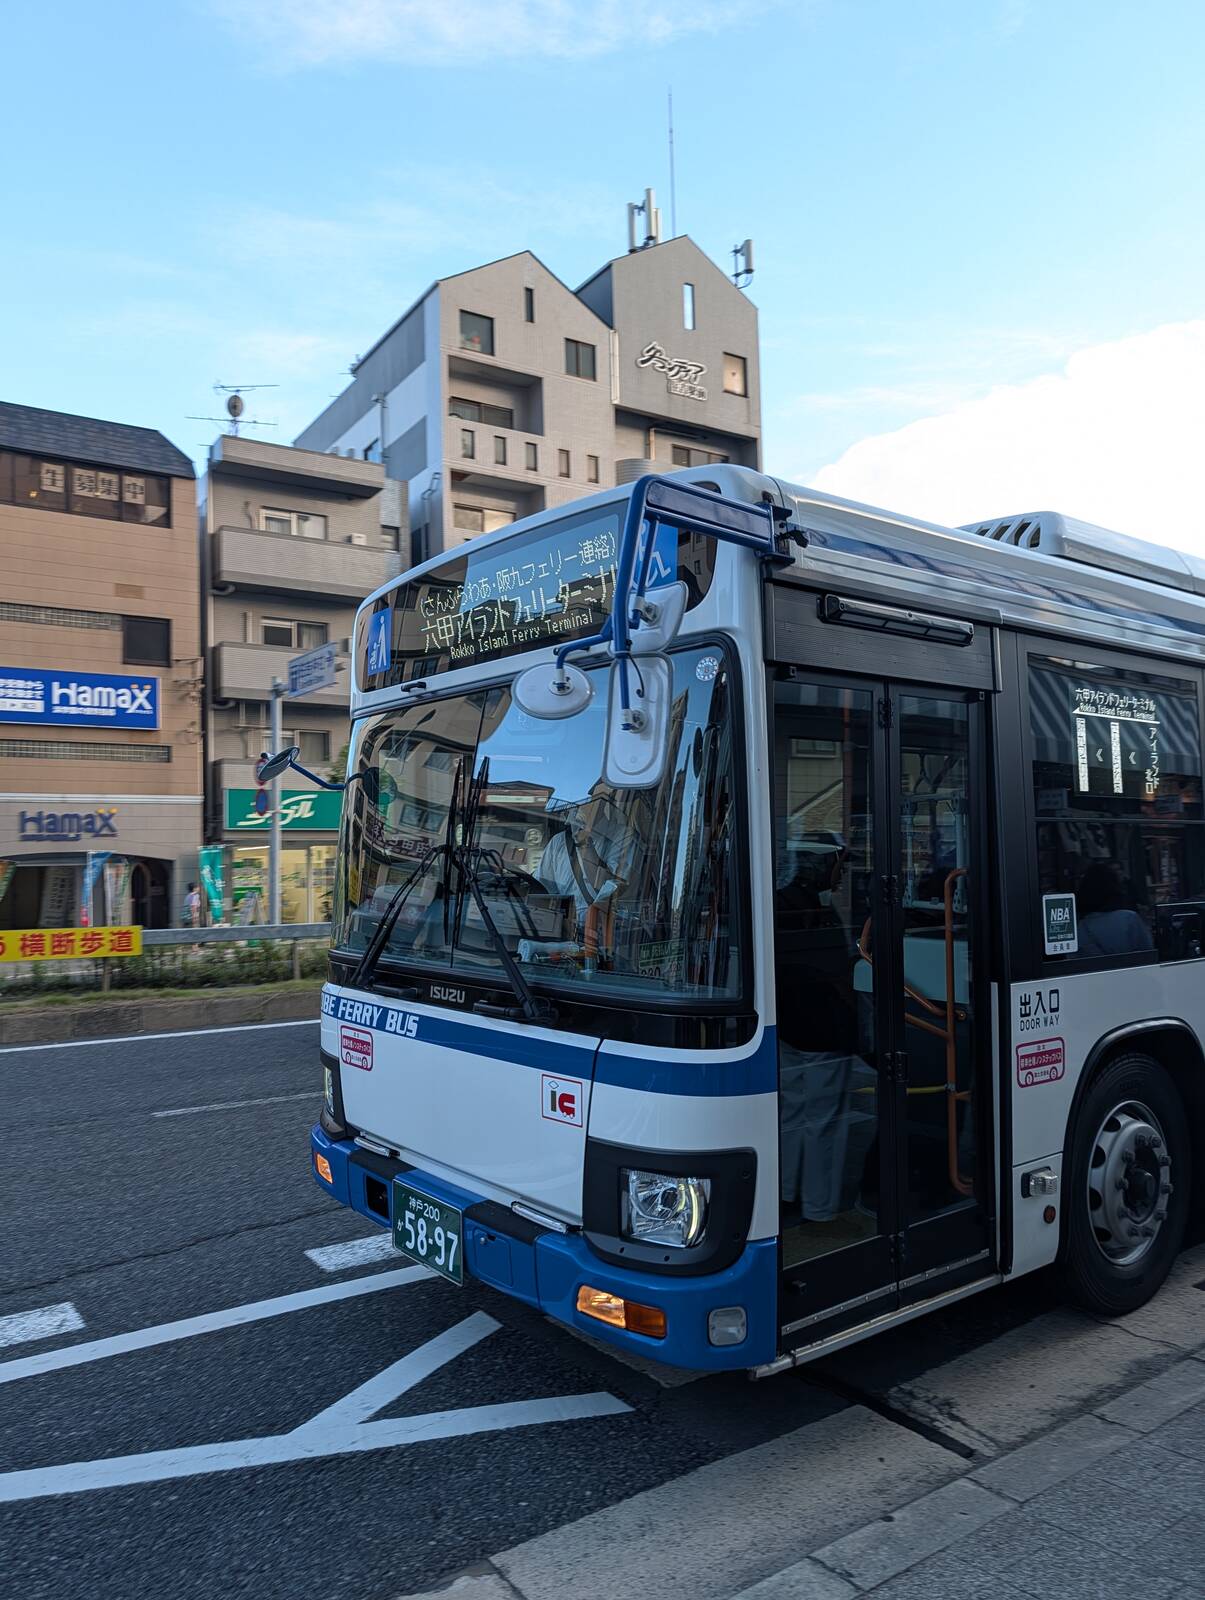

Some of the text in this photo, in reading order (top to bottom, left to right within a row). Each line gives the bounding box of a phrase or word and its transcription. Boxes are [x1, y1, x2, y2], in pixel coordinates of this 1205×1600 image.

[450, 608, 593, 660] Rokko Island Ferry Terminal
[1097, 704, 1116, 716] Island
[1050, 907, 1070, 921] NBA
[20, 929, 133, 957] 横断歩道
[430, 985, 466, 1004] ISUZU
[1019, 988, 1060, 1018] 出入口
[337, 999, 383, 1028] FERRY
[385, 1009, 420, 1038] BUS
[1019, 1013, 1060, 1032] DOOR WAY
[404, 1209, 459, 1273] 58-97
